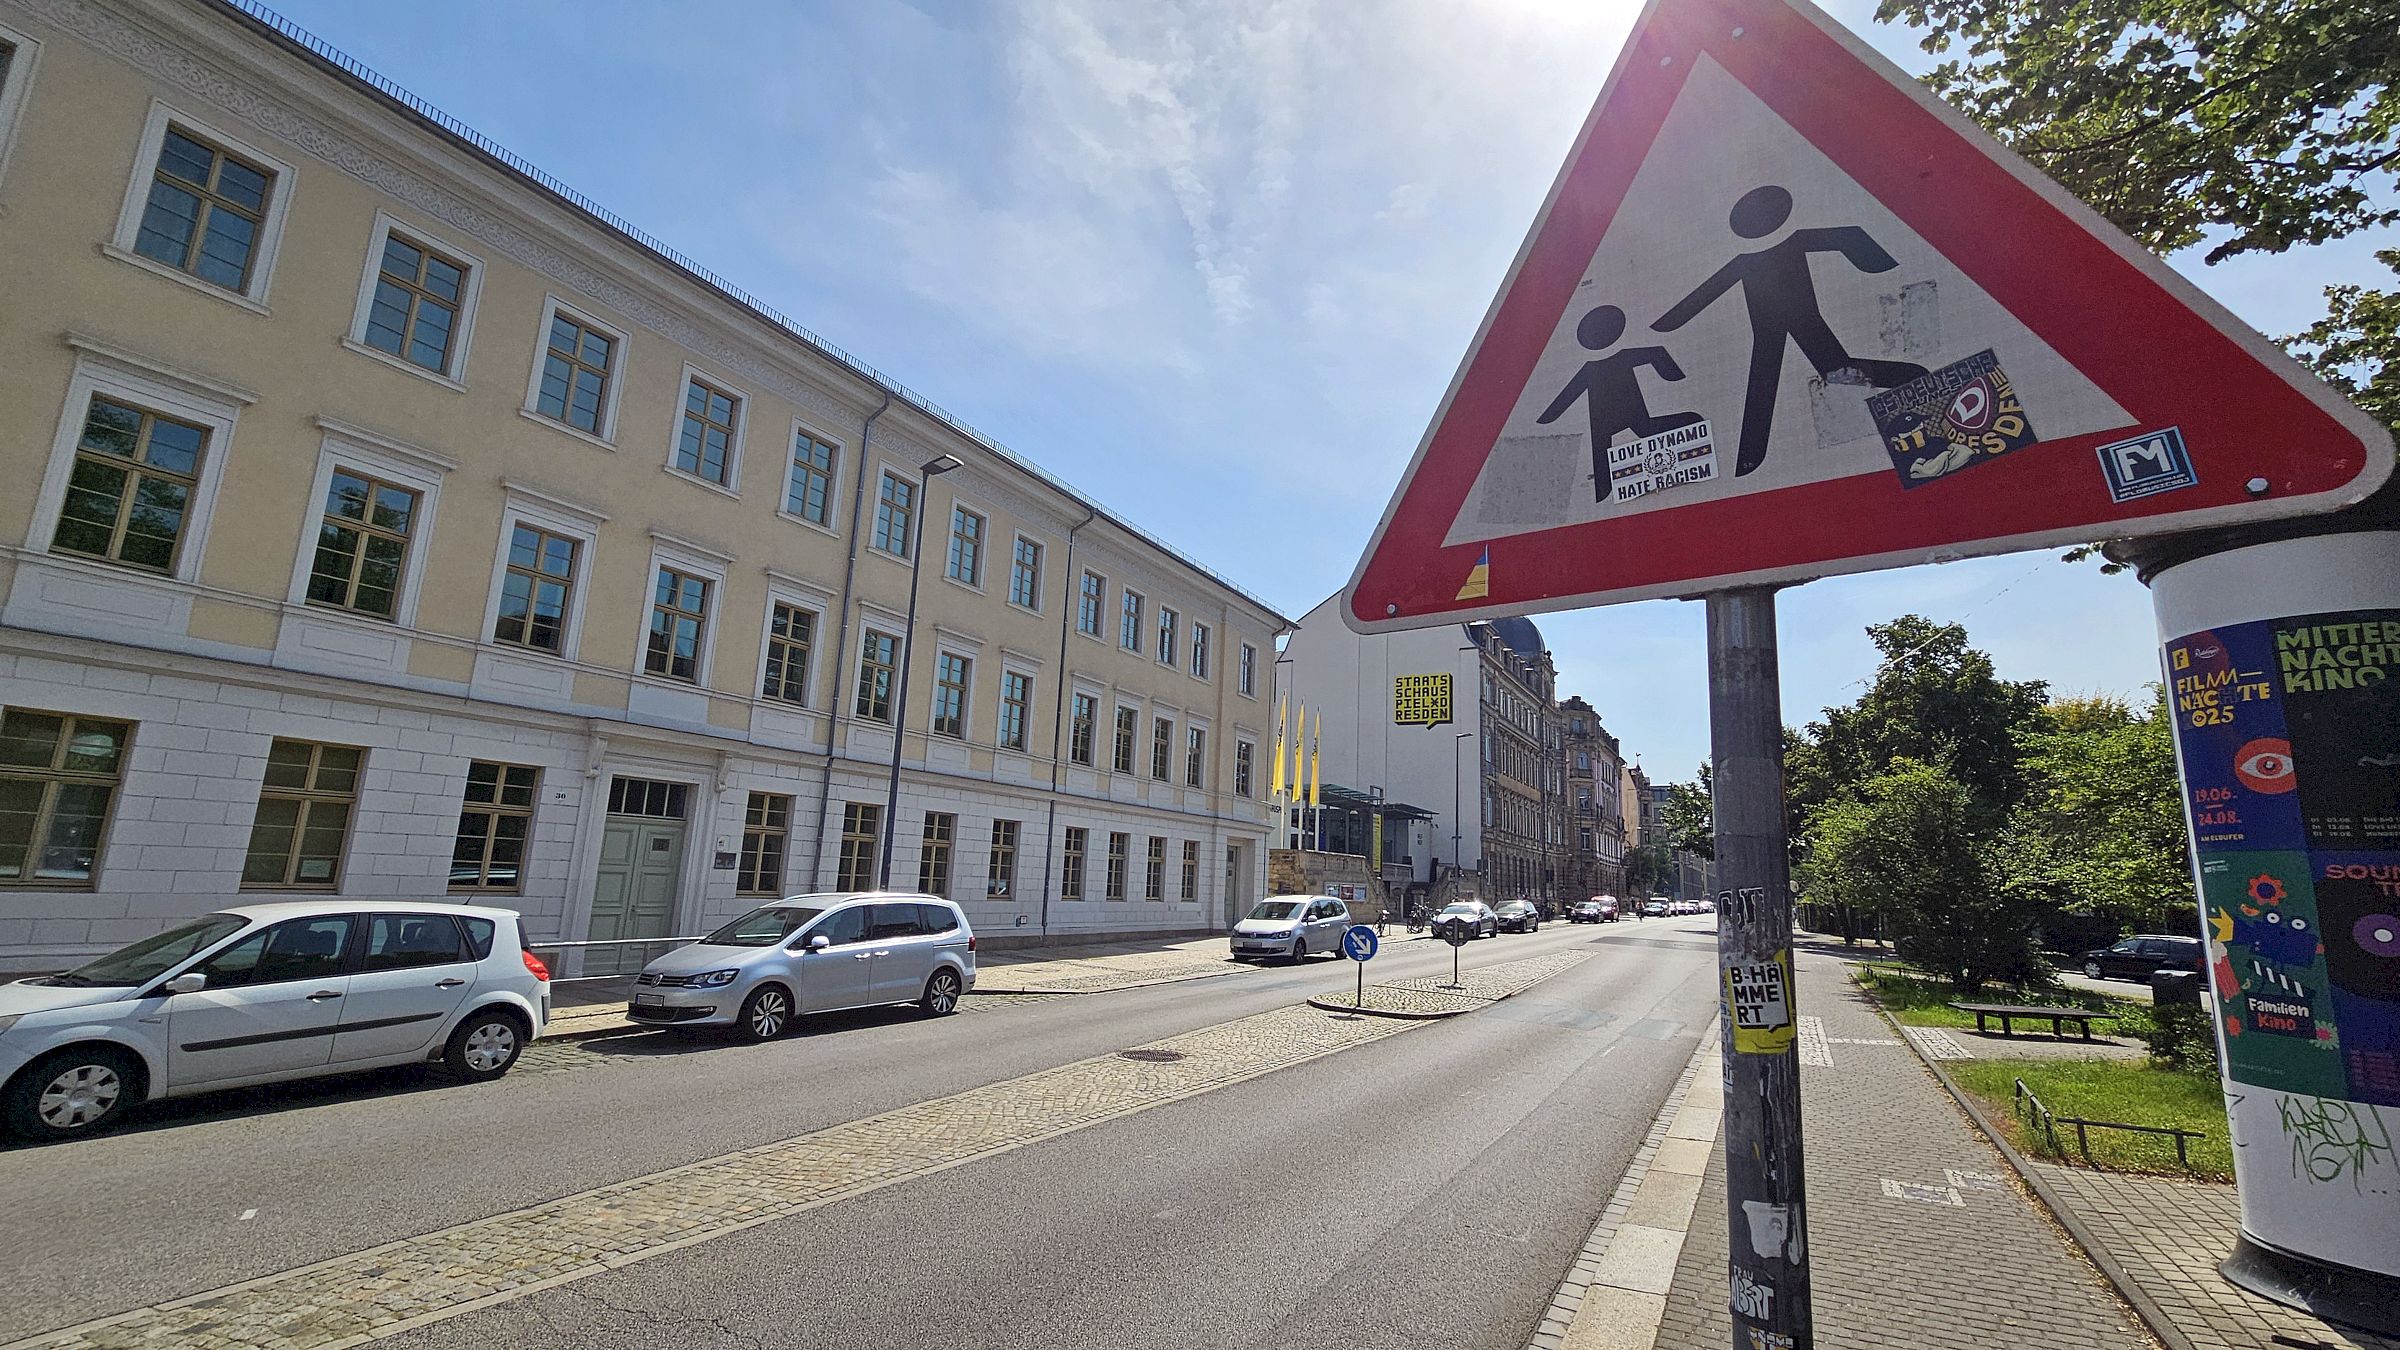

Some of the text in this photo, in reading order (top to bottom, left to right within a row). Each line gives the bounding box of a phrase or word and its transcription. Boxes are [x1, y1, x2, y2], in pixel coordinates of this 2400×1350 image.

[1610, 424, 1708, 464] LOVE DYNAMO
[2116, 439, 2172, 482] FM
[1618, 463, 1712, 500] HATE RACISM
[2276, 621, 2400, 651] MITTER
[2279, 643, 2400, 672] NACHT
[1395, 675, 1448, 688] STAATS
[1395, 686, 1448, 699] SCHAUS
[1395, 708, 1448, 720] RESDEN
[1737, 1004, 1764, 1024] RT
[2248, 997, 2310, 1018] Familien
[2257, 1013, 2297, 1031] Kino
